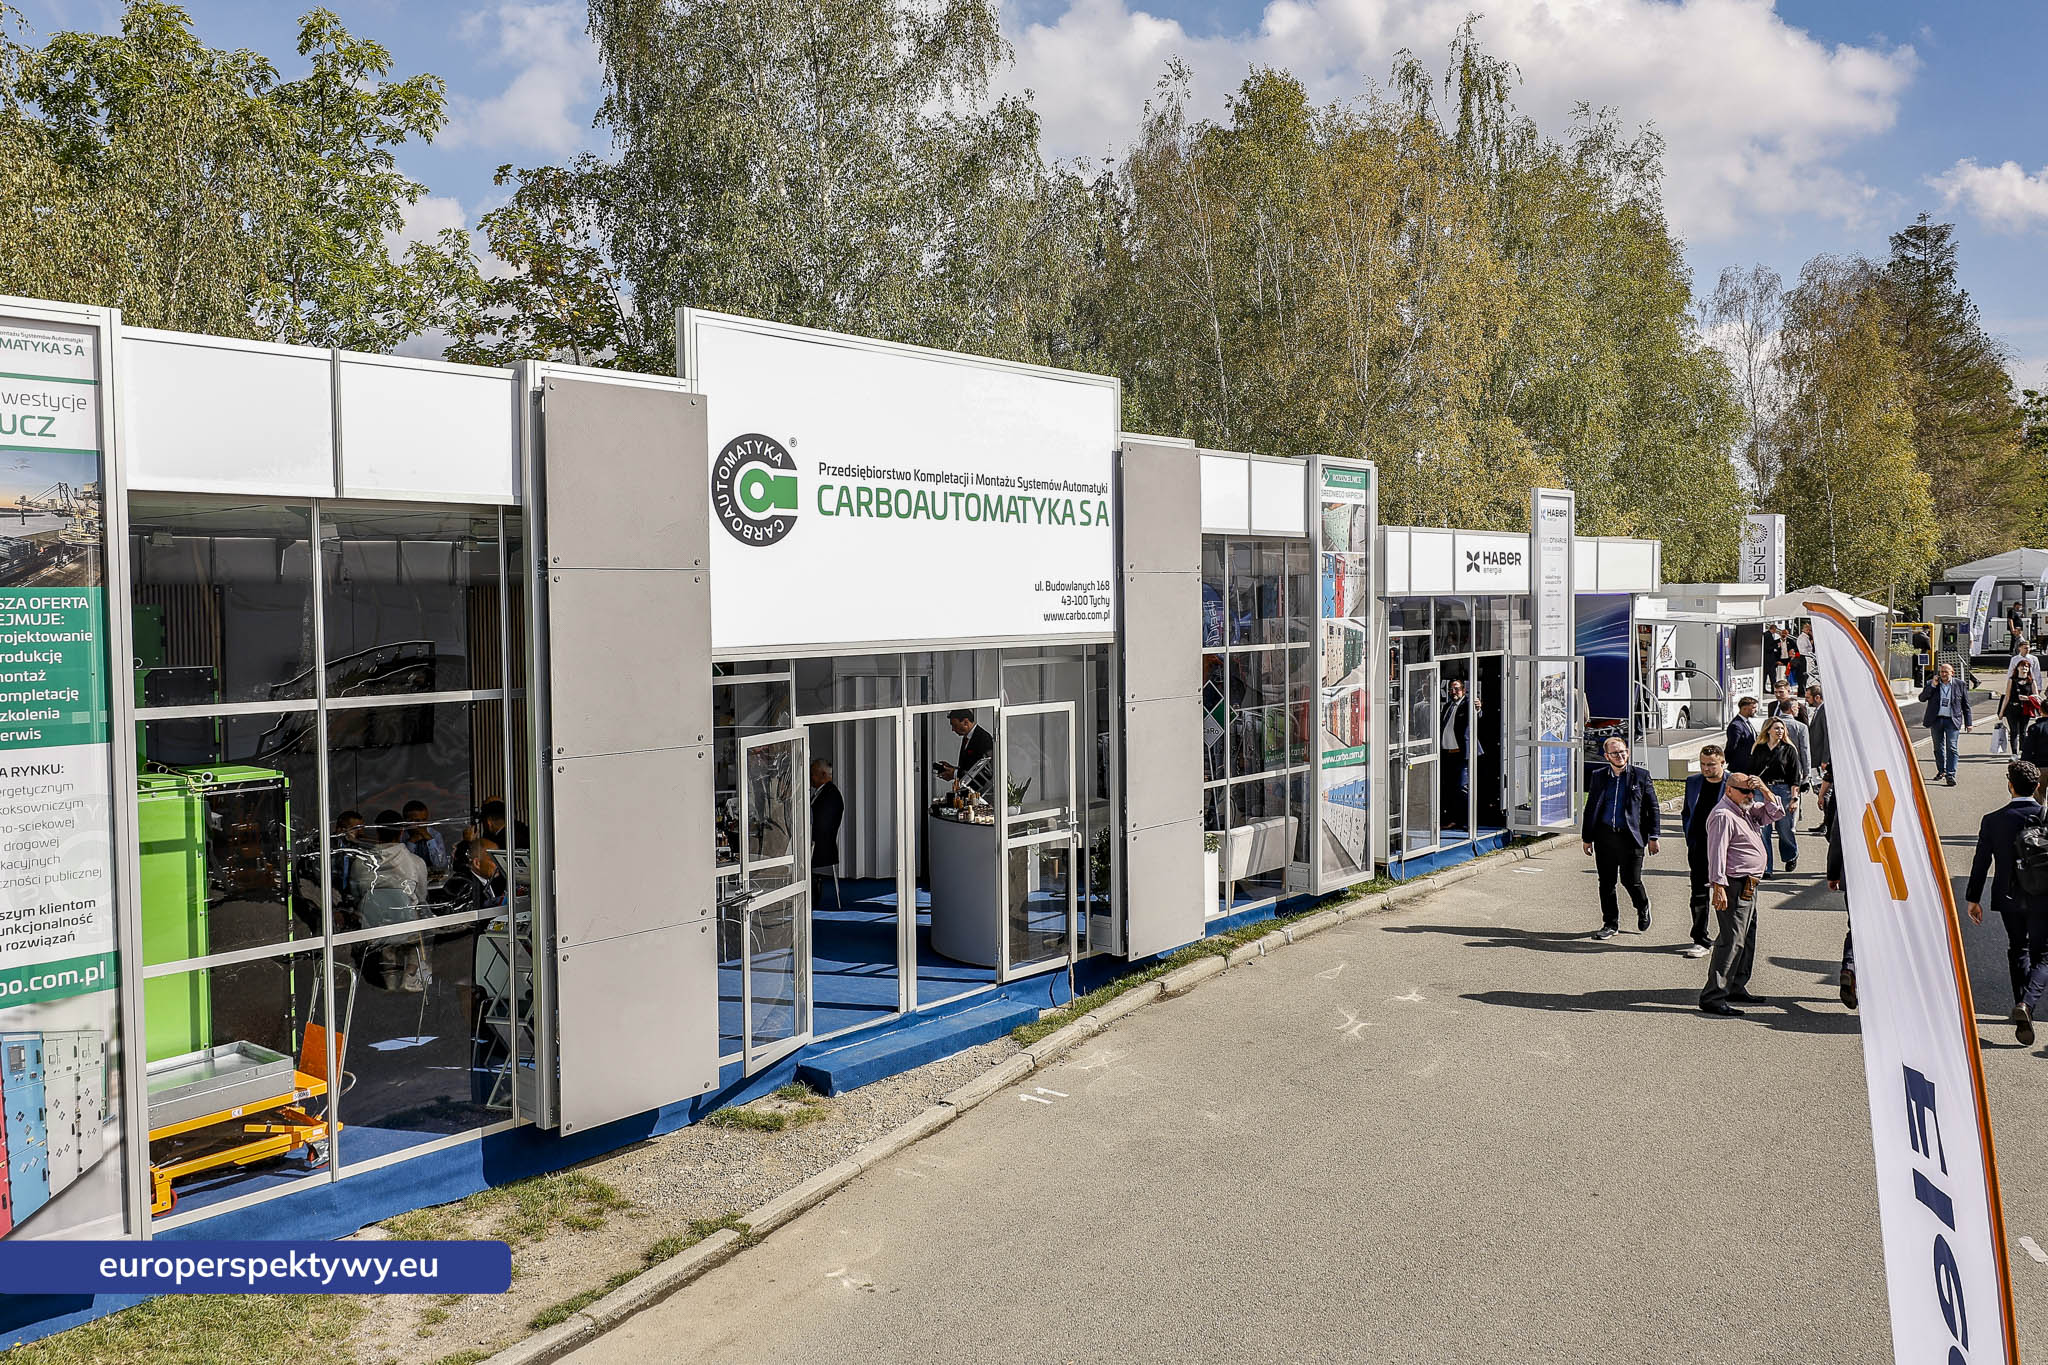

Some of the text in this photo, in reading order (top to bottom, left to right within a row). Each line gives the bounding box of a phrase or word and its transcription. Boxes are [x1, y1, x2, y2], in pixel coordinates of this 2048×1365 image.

[0, 337, 85, 356] MATYKA S A
[1, 391, 87, 412] westycje
[0, 413, 56, 437] UCZ
[819, 461, 1108, 496] Przedsiębiorstwo Kompletacji i Montażu Systemów Automatyki
[817, 484, 1110, 527] CARBOAUTOMATYKA S A
[1753, 546, 1766, 585] ENER
[1035, 580, 1110, 593] ul. Budowlanych 168
[29, 596, 89, 609] OFERTA
[1061, 595, 1110, 608] 43-100 Tychy
[1043, 609, 1110, 622] www.carbo.com.pl
[0, 707, 60, 722] zkolenia
[0, 727, 41, 741] erwis
[11, 763, 64, 777] RYNKU:
[0, 782, 74, 798] rgetycznym
[4, 836, 59, 851] drogowej
[44, 867, 102, 885] publicznej
[39, 899, 96, 916] klientom
[6, 931, 76, 951] rozwiązań
[1902, 1062, 1969, 1365] Ele
